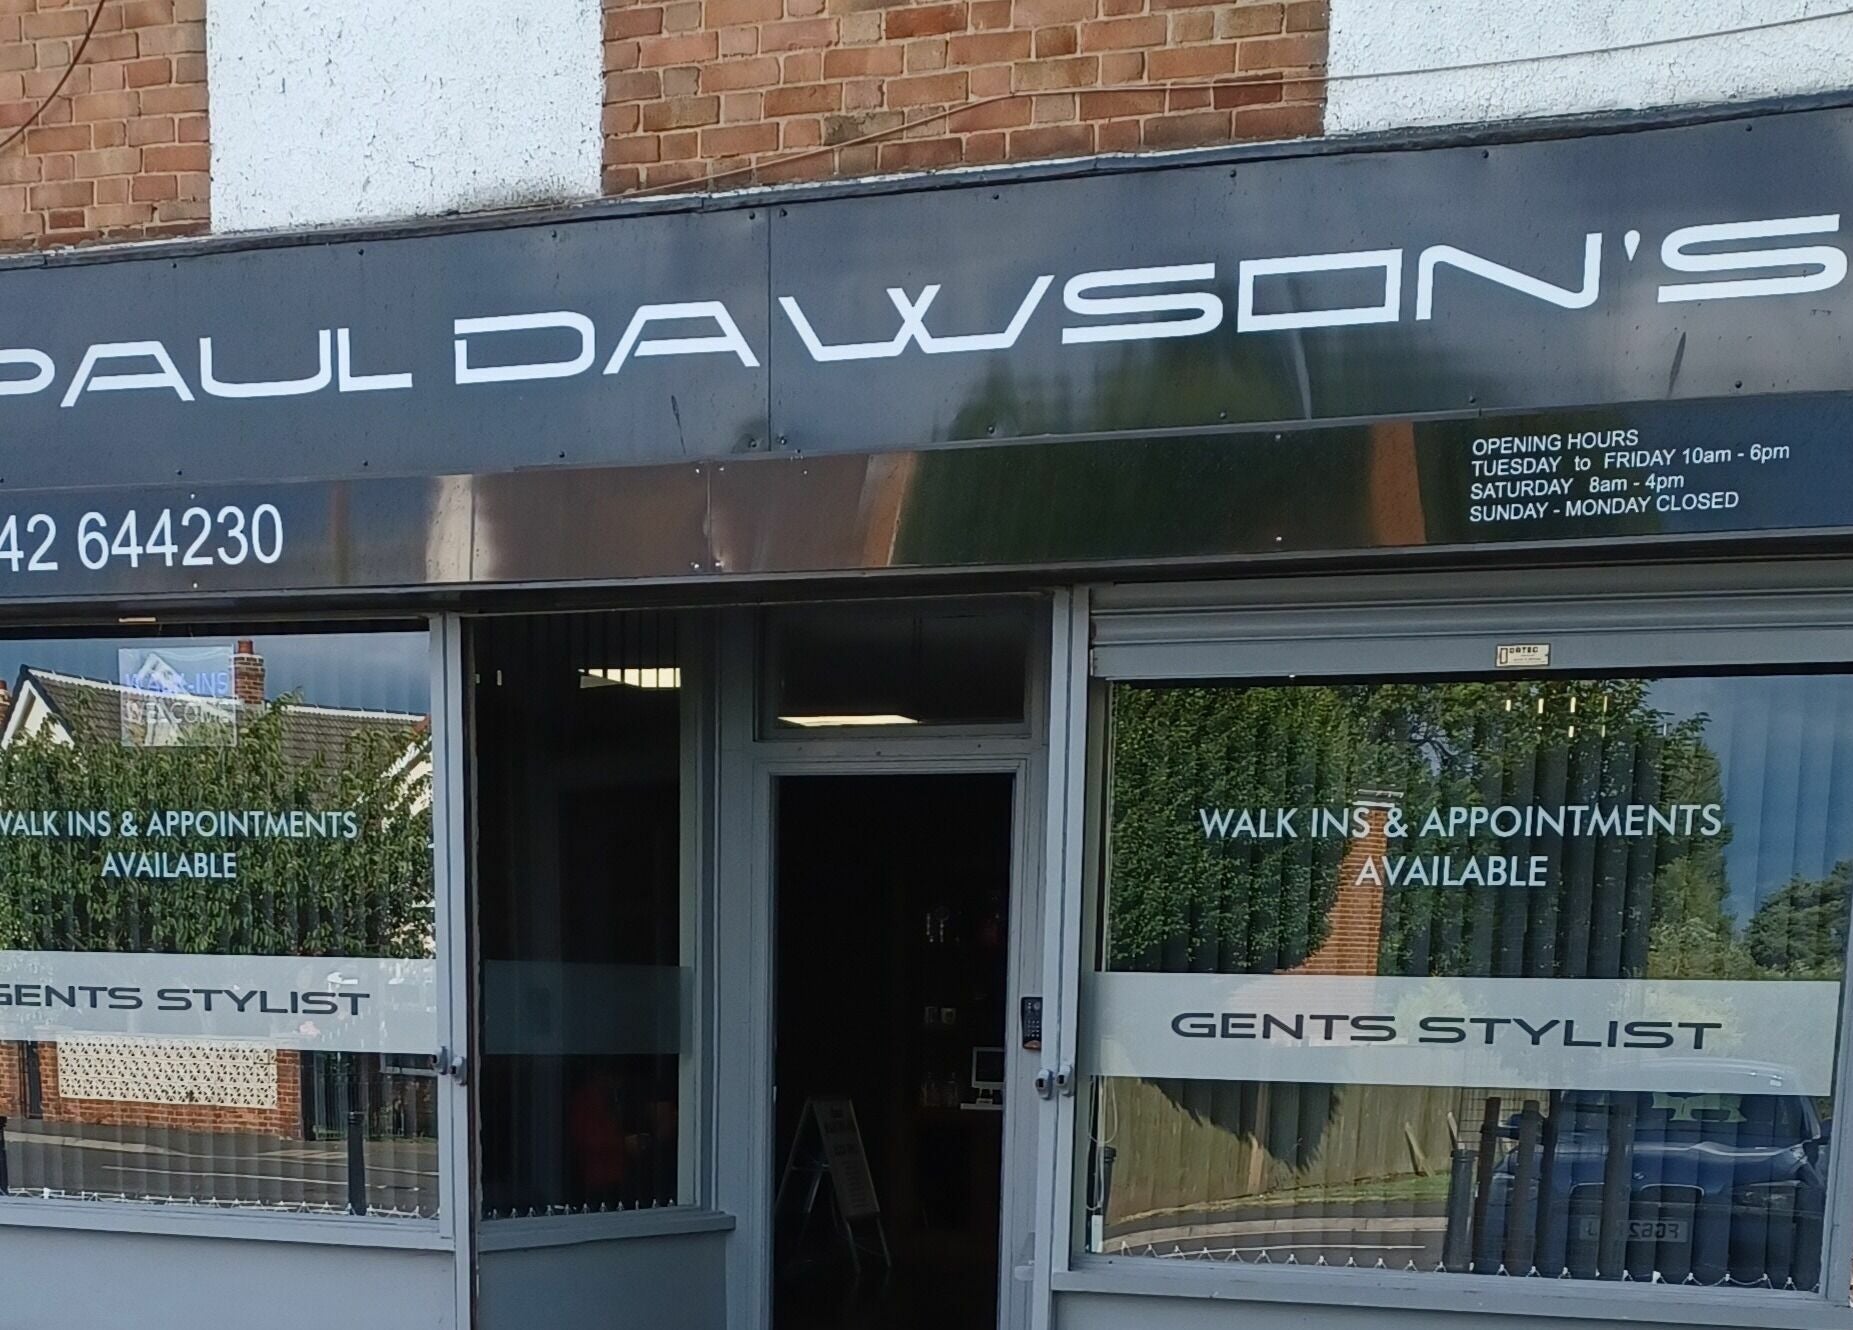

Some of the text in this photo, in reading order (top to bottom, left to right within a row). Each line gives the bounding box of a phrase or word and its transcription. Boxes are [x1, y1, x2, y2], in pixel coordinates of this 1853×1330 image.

[455, 213, 1849, 385] DAWSON'S
[1472, 429, 1639, 456] OPENING HOURS
[1471, 456, 1563, 477] TUESDAY
[1575, 457, 1591, 471] to
[1604, 449, 1677, 469] FRIDAY
[1682, 447, 1732, 465] 10am
[1750, 443, 1790, 463] 6pm
[1470, 477, 1574, 500] SATURDAY
[1589, 476, 1628, 493] 8am
[1645, 473, 1685, 491] 4pm
[1469, 502, 1549, 523] SUNDAY
[1565, 496, 1651, 518] MONDAY
[1656, 491, 1740, 512] CLOSED
[0, 503, 284, 572] 42 644230
[68, 810, 112, 837] INS
[119, 810, 138, 837] &
[146, 810, 358, 838] APPOINTMENTS
[1200, 803, 1722, 839] WALK INS & APPOINTMENTS
[101, 851, 237, 878] AVAILABLE
[1355, 855, 1549, 887] AVAILABLE
[157, 988, 371, 1016] STYLIST
[1171, 1012, 1723, 1050] GENTS STYLIST
